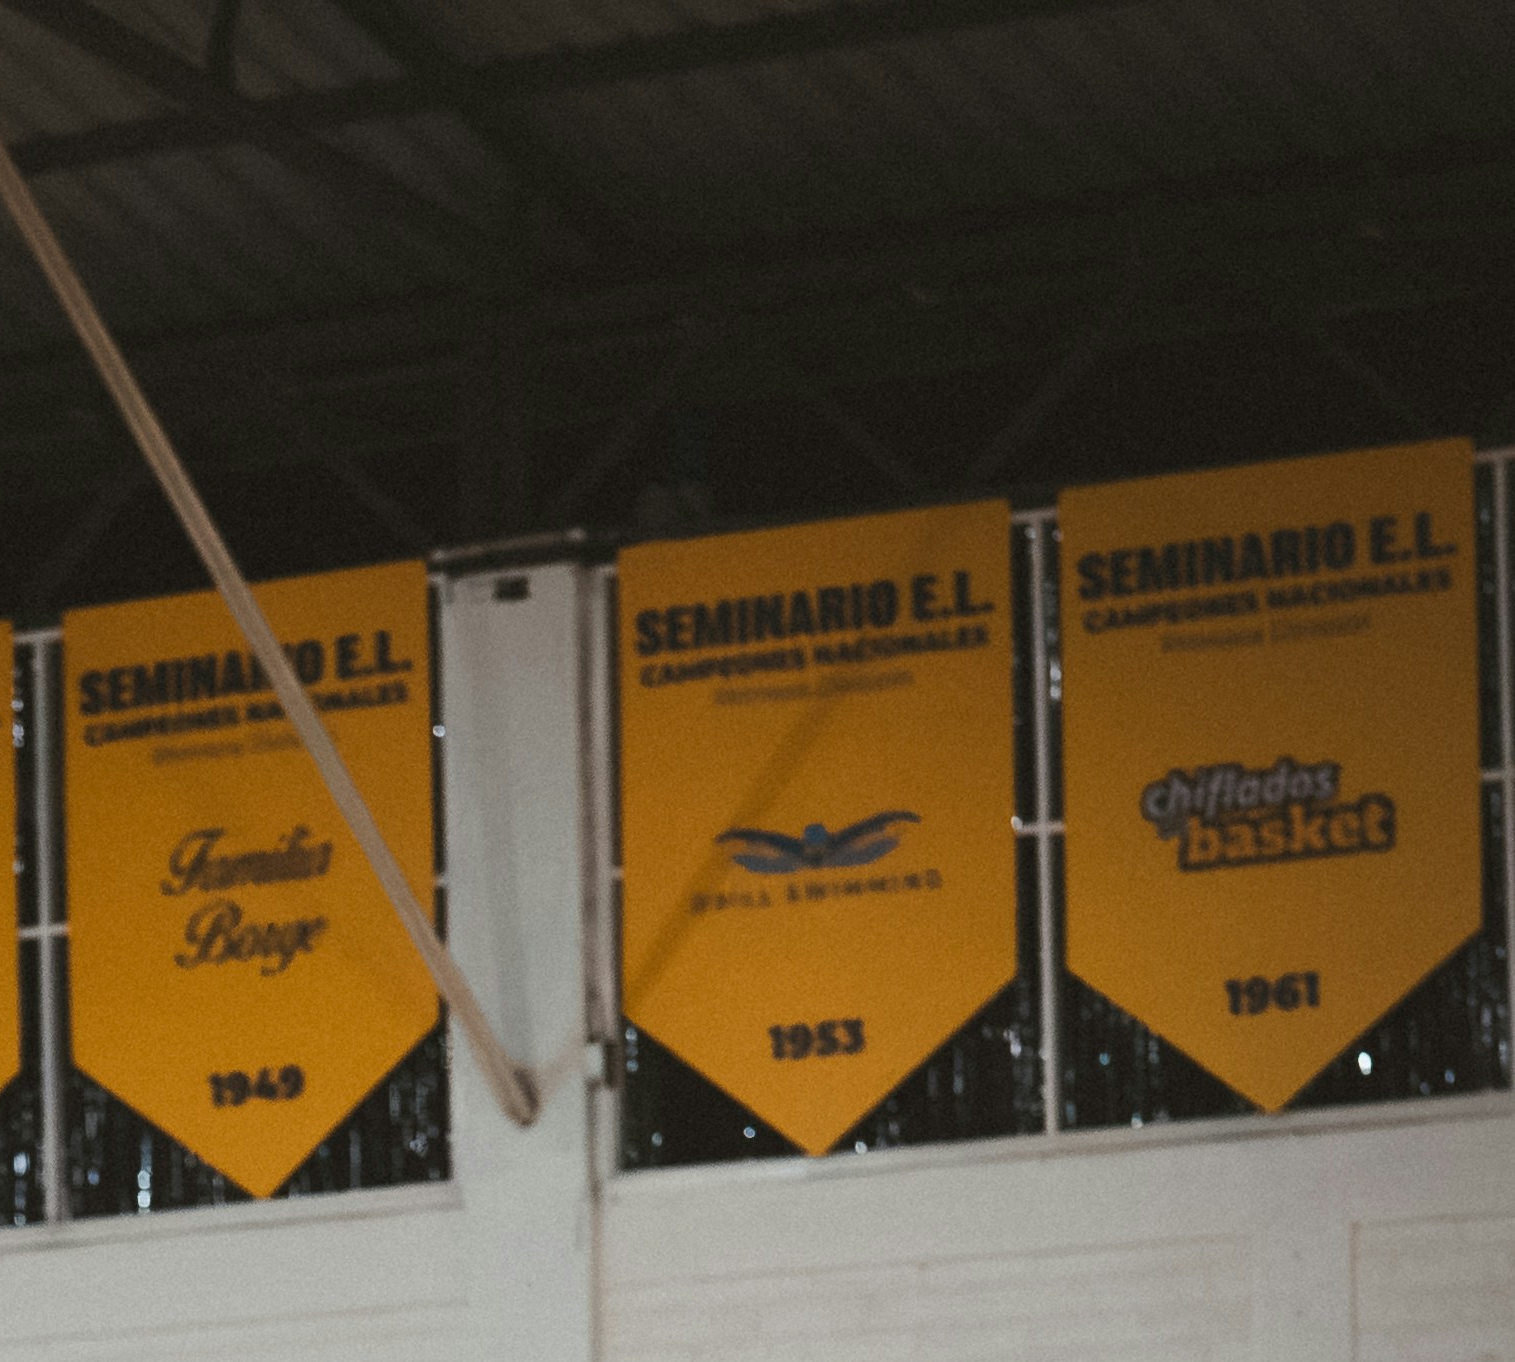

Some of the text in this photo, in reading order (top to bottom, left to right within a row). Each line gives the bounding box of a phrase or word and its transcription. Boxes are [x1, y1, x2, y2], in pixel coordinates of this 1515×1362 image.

[1076, 521, 1358, 601] SEMINARIO
[636, 579, 899, 657] SEMINARIO
[80, 638, 324, 717] SEMINAO
[1142, 758, 1339, 825] chiflados
[1186, 799, 1390, 864] basket
[1225, 971, 1320, 1015] 1961
[768, 1018, 866, 1061] 1953
[207, 1065, 305, 1109] 1949
